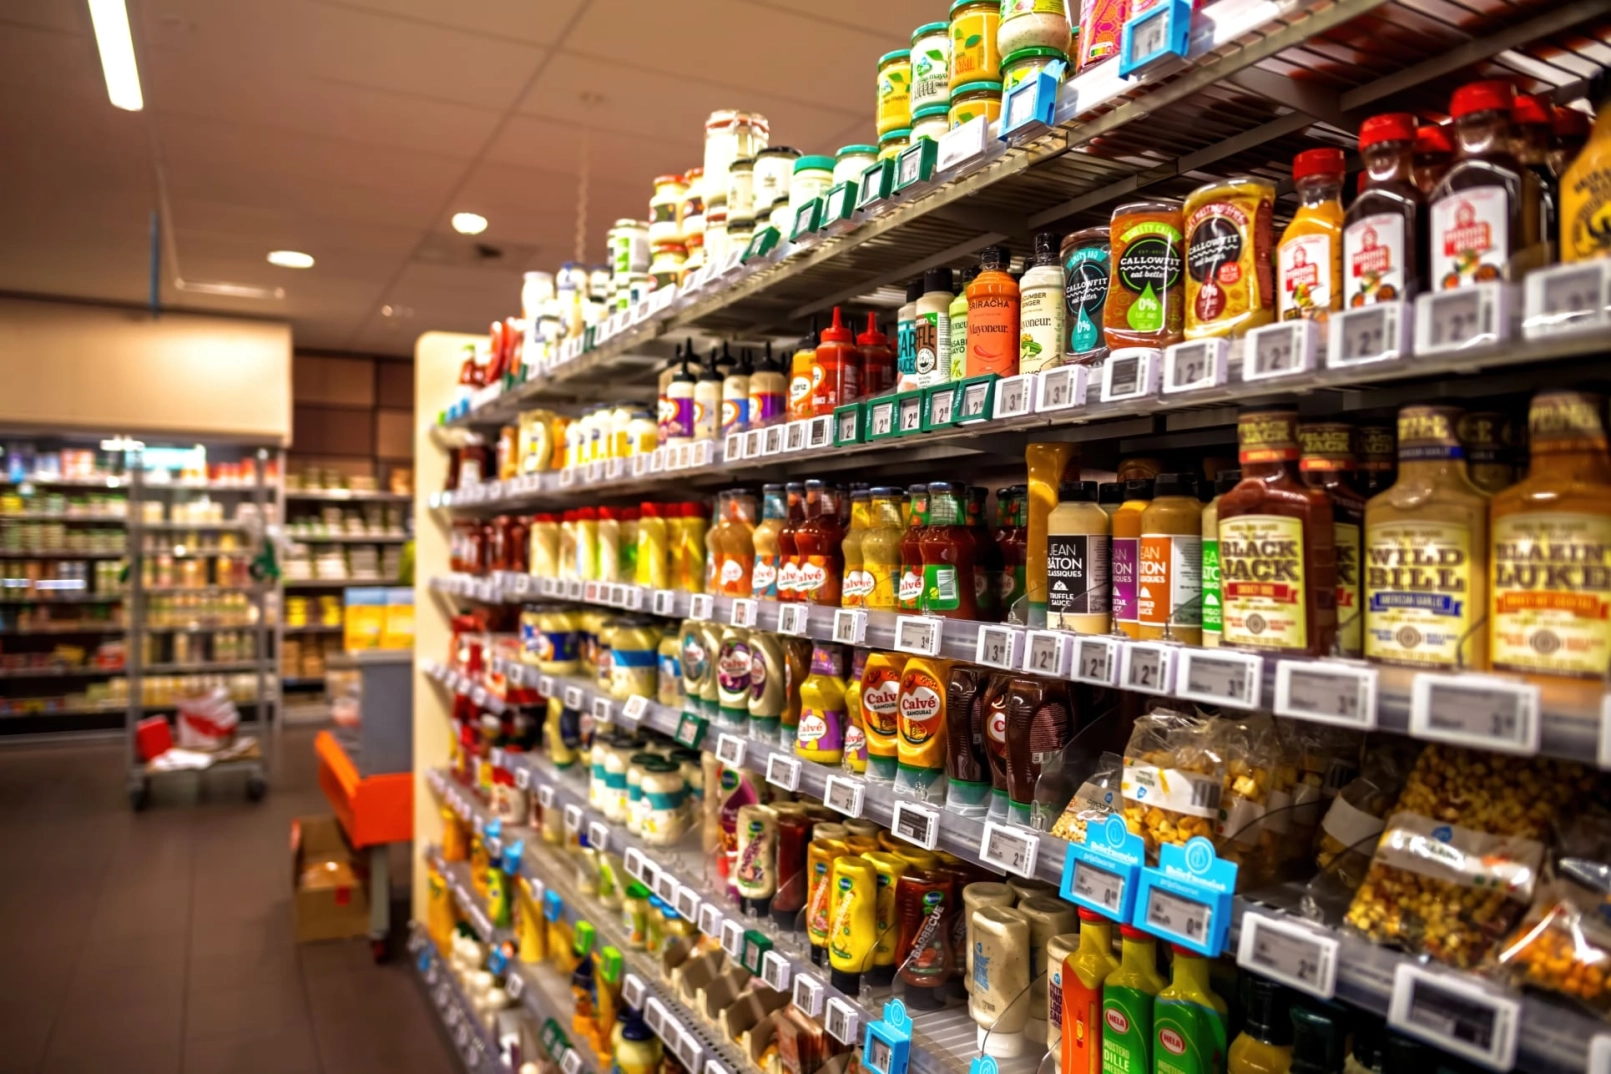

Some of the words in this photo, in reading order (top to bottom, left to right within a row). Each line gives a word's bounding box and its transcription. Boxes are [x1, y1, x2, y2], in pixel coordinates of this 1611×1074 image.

[1120, 256, 1182, 267] CALLOWFIT
[969, 300, 1010, 311] SRIRACHA
[1138, 298, 1158, 311] 0%
[1049, 543, 1076, 556] JEAN
[1222, 541, 1298, 559] BLACK
[1369, 548, 1464, 567] WILD
[1222, 559, 1300, 581] JACK
[1369, 567, 1466, 592] BILL
[902, 695, 936, 710] Calvé
[912, 904, 945, 959] BARBECUE
[1108, 1013, 1126, 1027] HELA
[1162, 1032, 1182, 1048] HELA
[1103, 1051, 1130, 1072] DILLE
